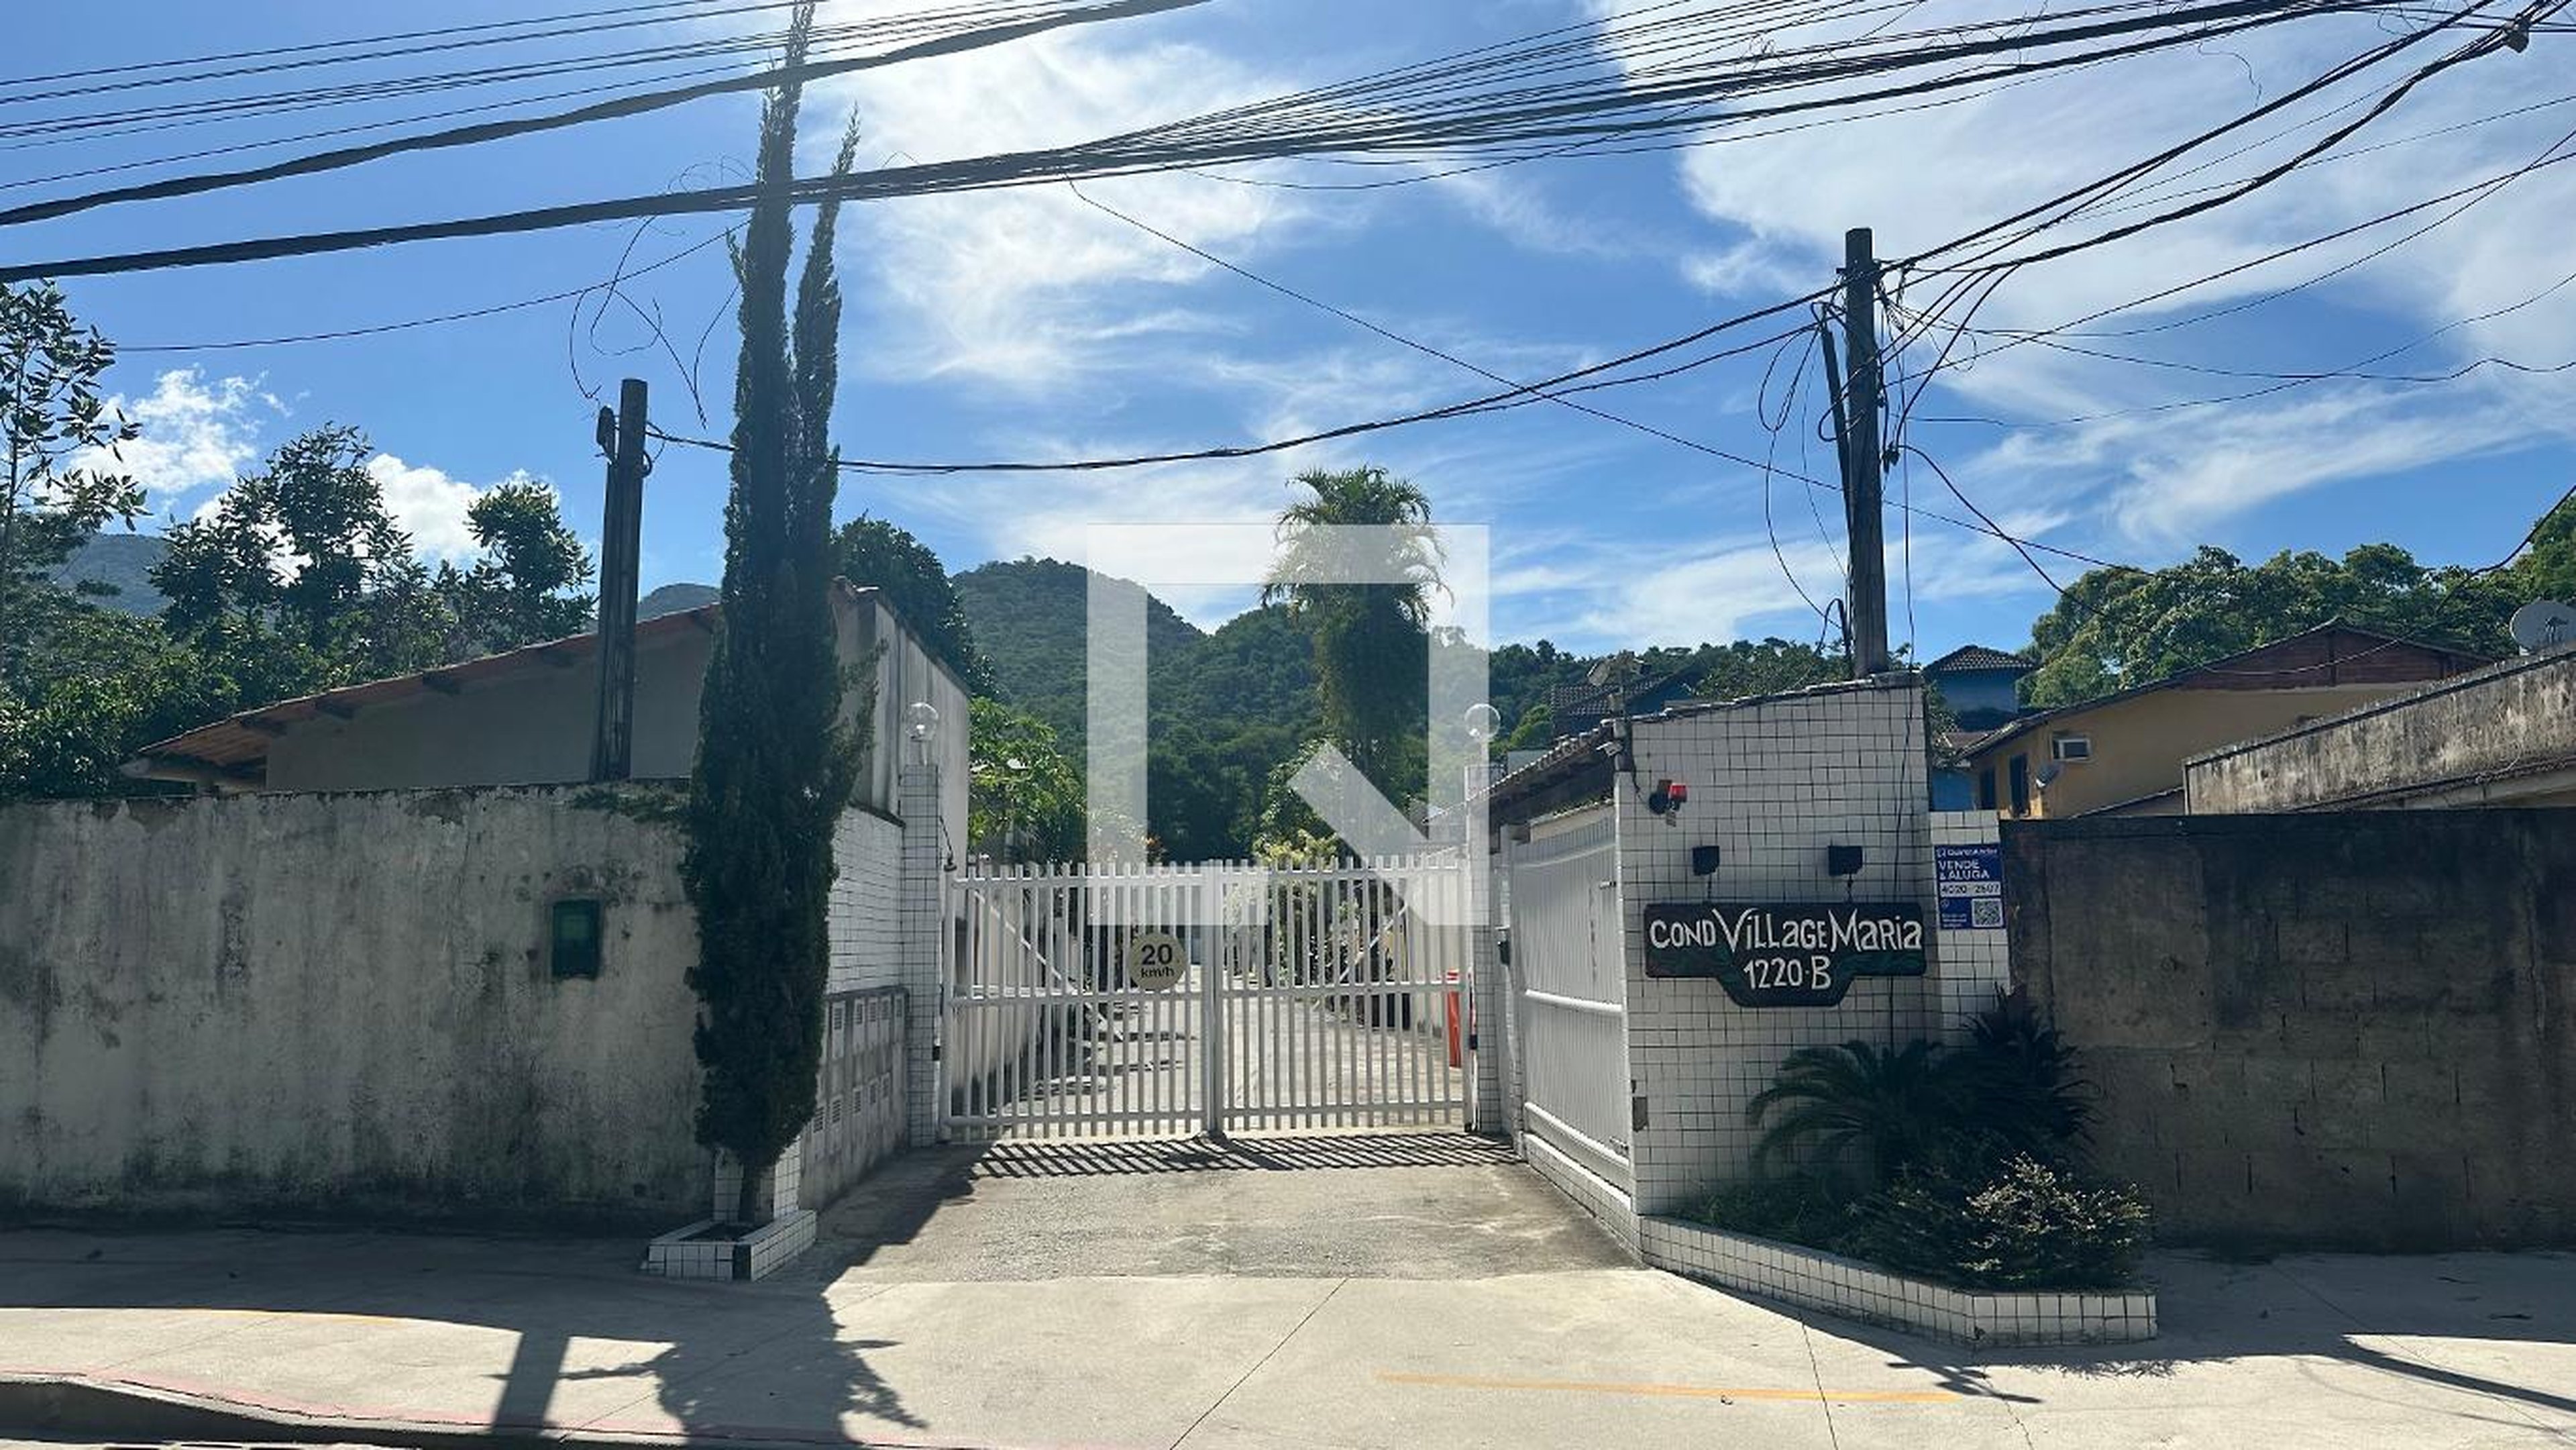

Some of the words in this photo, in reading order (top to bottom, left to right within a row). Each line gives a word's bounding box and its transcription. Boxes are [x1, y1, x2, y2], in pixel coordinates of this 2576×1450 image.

[1937, 860, 1980, 870] VENDE
[1947, 870, 1990, 880] ALUGA
[1649, 919, 1716, 949] COND
[1142, 943, 1173, 965] 20
[1141, 966, 1175, 978] km/h
